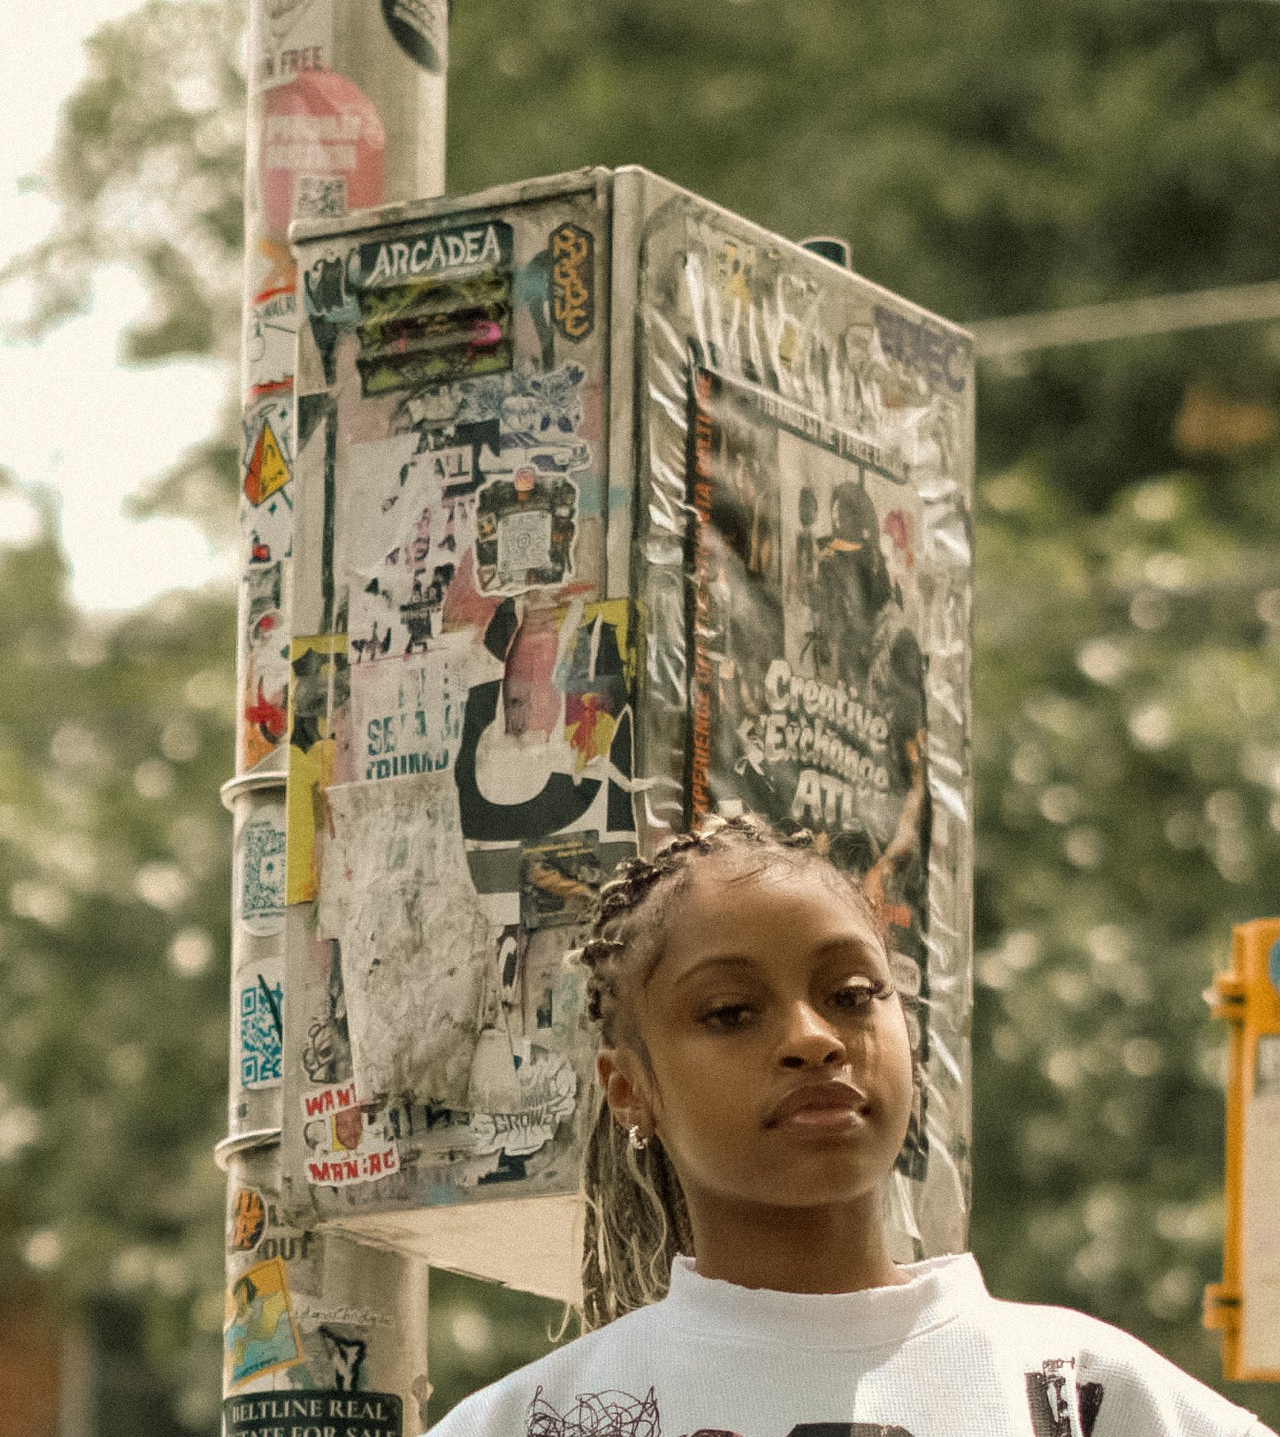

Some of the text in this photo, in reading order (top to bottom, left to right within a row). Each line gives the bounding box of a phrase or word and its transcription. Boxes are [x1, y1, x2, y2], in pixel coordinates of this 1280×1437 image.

[365, 225, 501, 286] ARCADEA
[765, 659, 890, 751] Creative
[765, 711, 891, 799] Exchange
[791, 769, 863, 830] ATL
[232, 1399, 388, 1423] BELTLINE REAL
